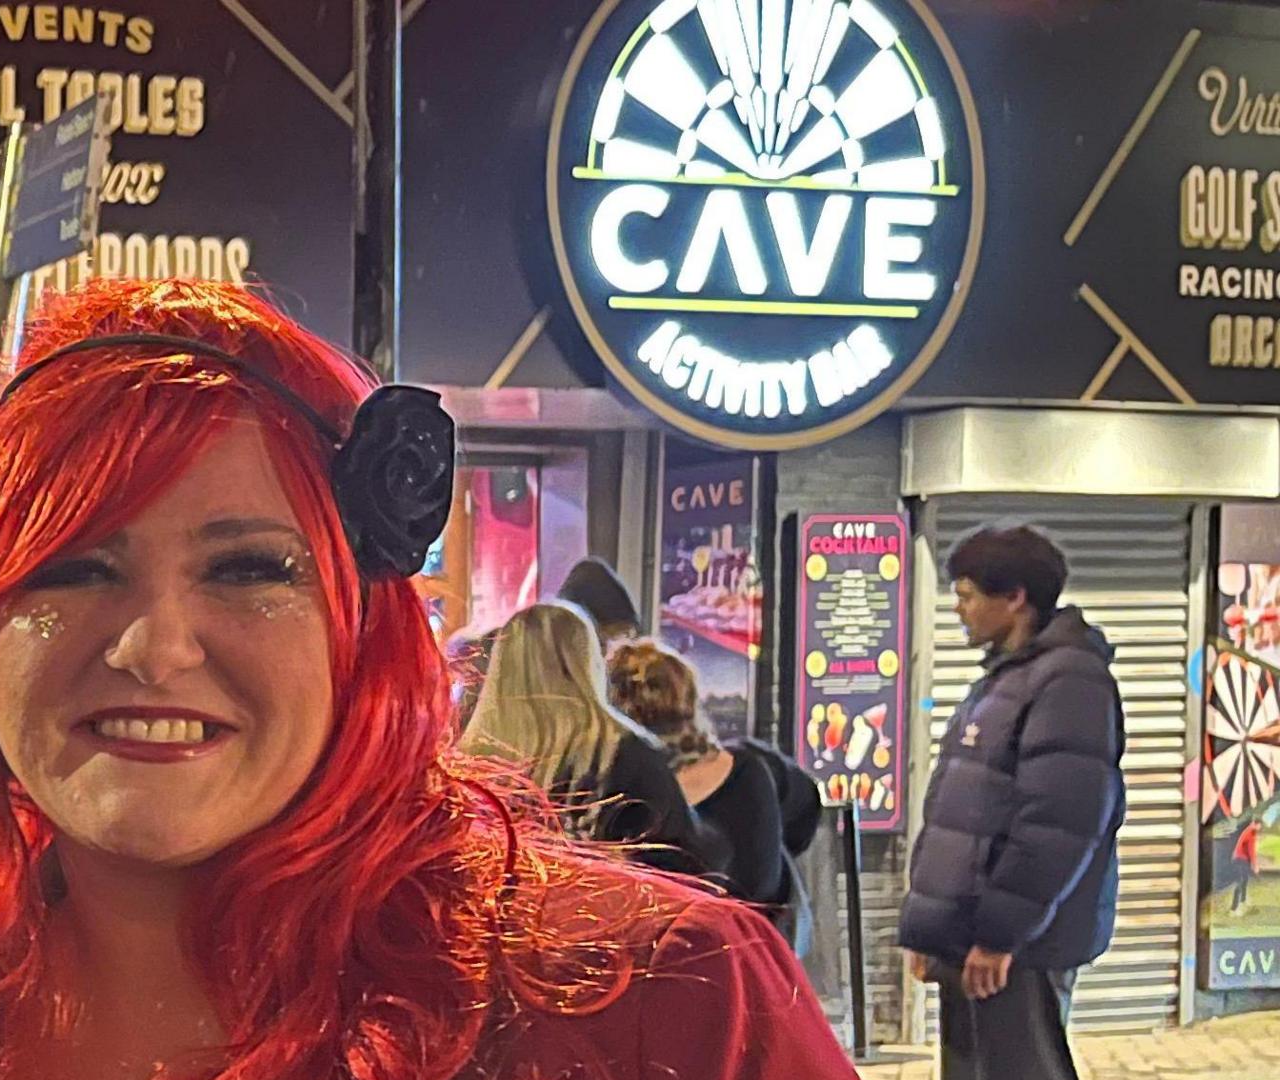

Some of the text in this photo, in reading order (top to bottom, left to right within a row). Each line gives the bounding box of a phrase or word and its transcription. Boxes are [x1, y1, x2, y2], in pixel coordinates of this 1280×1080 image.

[1180, 165, 1259, 251] GOLF
[589, 184, 937, 300] CAVE
[1179, 264, 1280, 300] RACIN
[637, 320, 894, 418] ACTIVITY BAR
[671, 480, 744, 511] CAVE
[809, 535, 898, 554] COCKTAILS
[832, 522, 876, 539] CAVE
[1219, 949, 1275, 975] CAV
